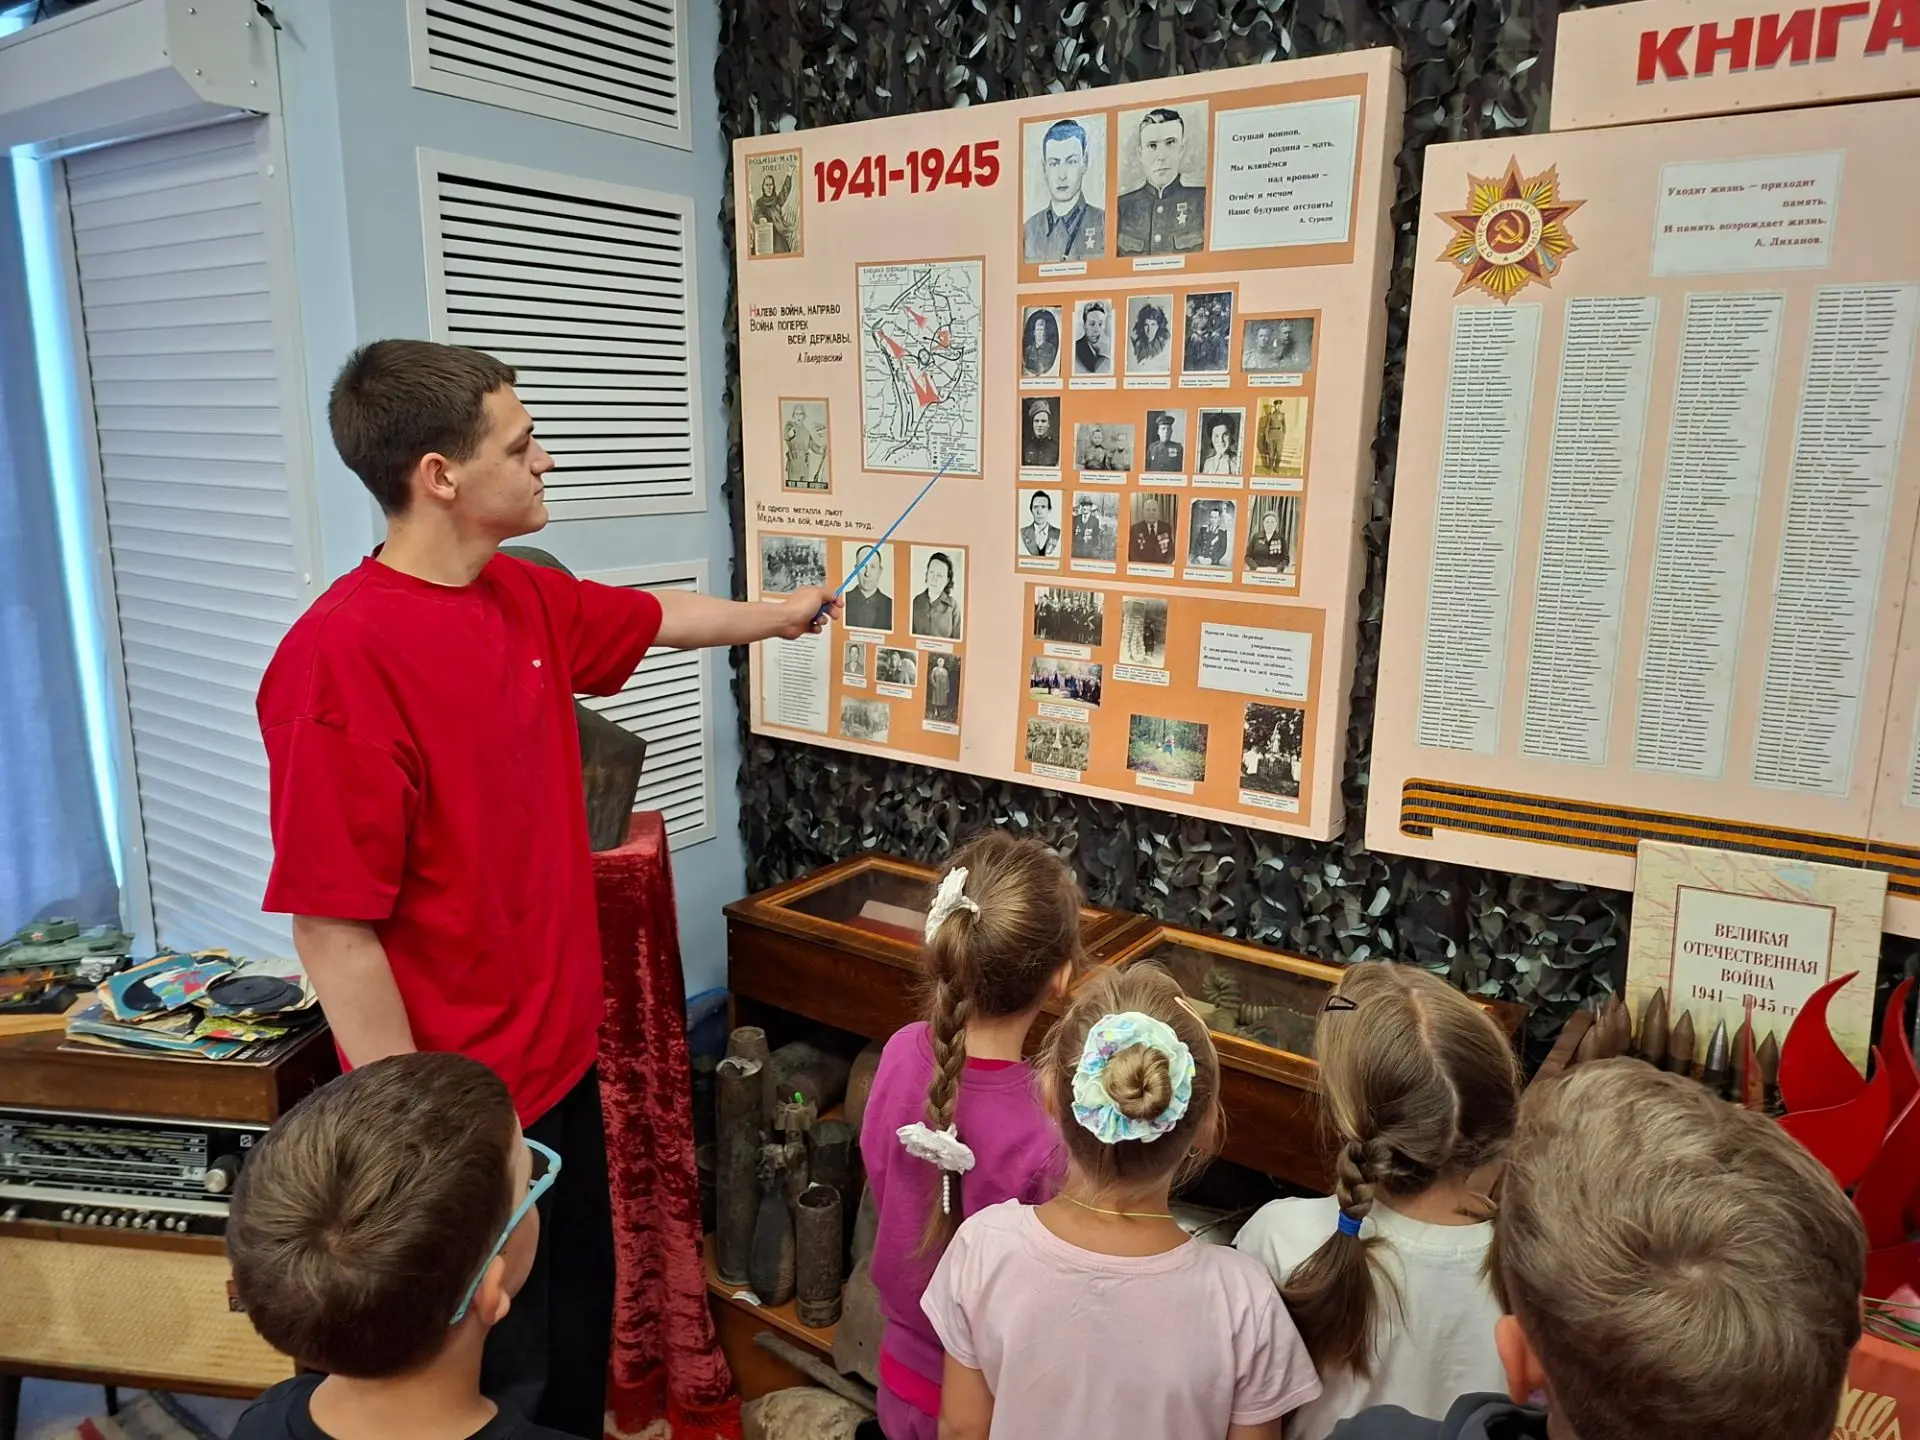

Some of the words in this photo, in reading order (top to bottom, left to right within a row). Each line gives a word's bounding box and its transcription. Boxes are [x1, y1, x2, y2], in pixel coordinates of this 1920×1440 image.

[1637, 0, 1920, 85] КНИГА
[1232, 132, 1264, 142] Слушай
[1270, 144, 1300, 155] родина
[814, 140, 999, 202] 1941-1945
[1248, 161, 1287, 170] клянёмся
[1287, 173, 1319, 183] кровью
[1668, 187, 1706, 196] Уходит
[1710, 184, 1745, 193] жизнь
[1761, 179, 1815, 192] приходит
[1229, 193, 1254, 201] Огнём
[1267, 190, 1292, 198] мечом
[1664, 225, 1673, 233] И
[1677, 224, 1715, 232] память
[1719, 220, 1783, 231] возрождает
[1755, 239, 1765, 247] А.
[1715, 923, 1789, 948] ВЕЛИКАЯ
[1683, 940, 1819, 975] ОТЕЧЕСТВЕННАЯ
[1721, 968, 1775, 990] ВОЙНА
